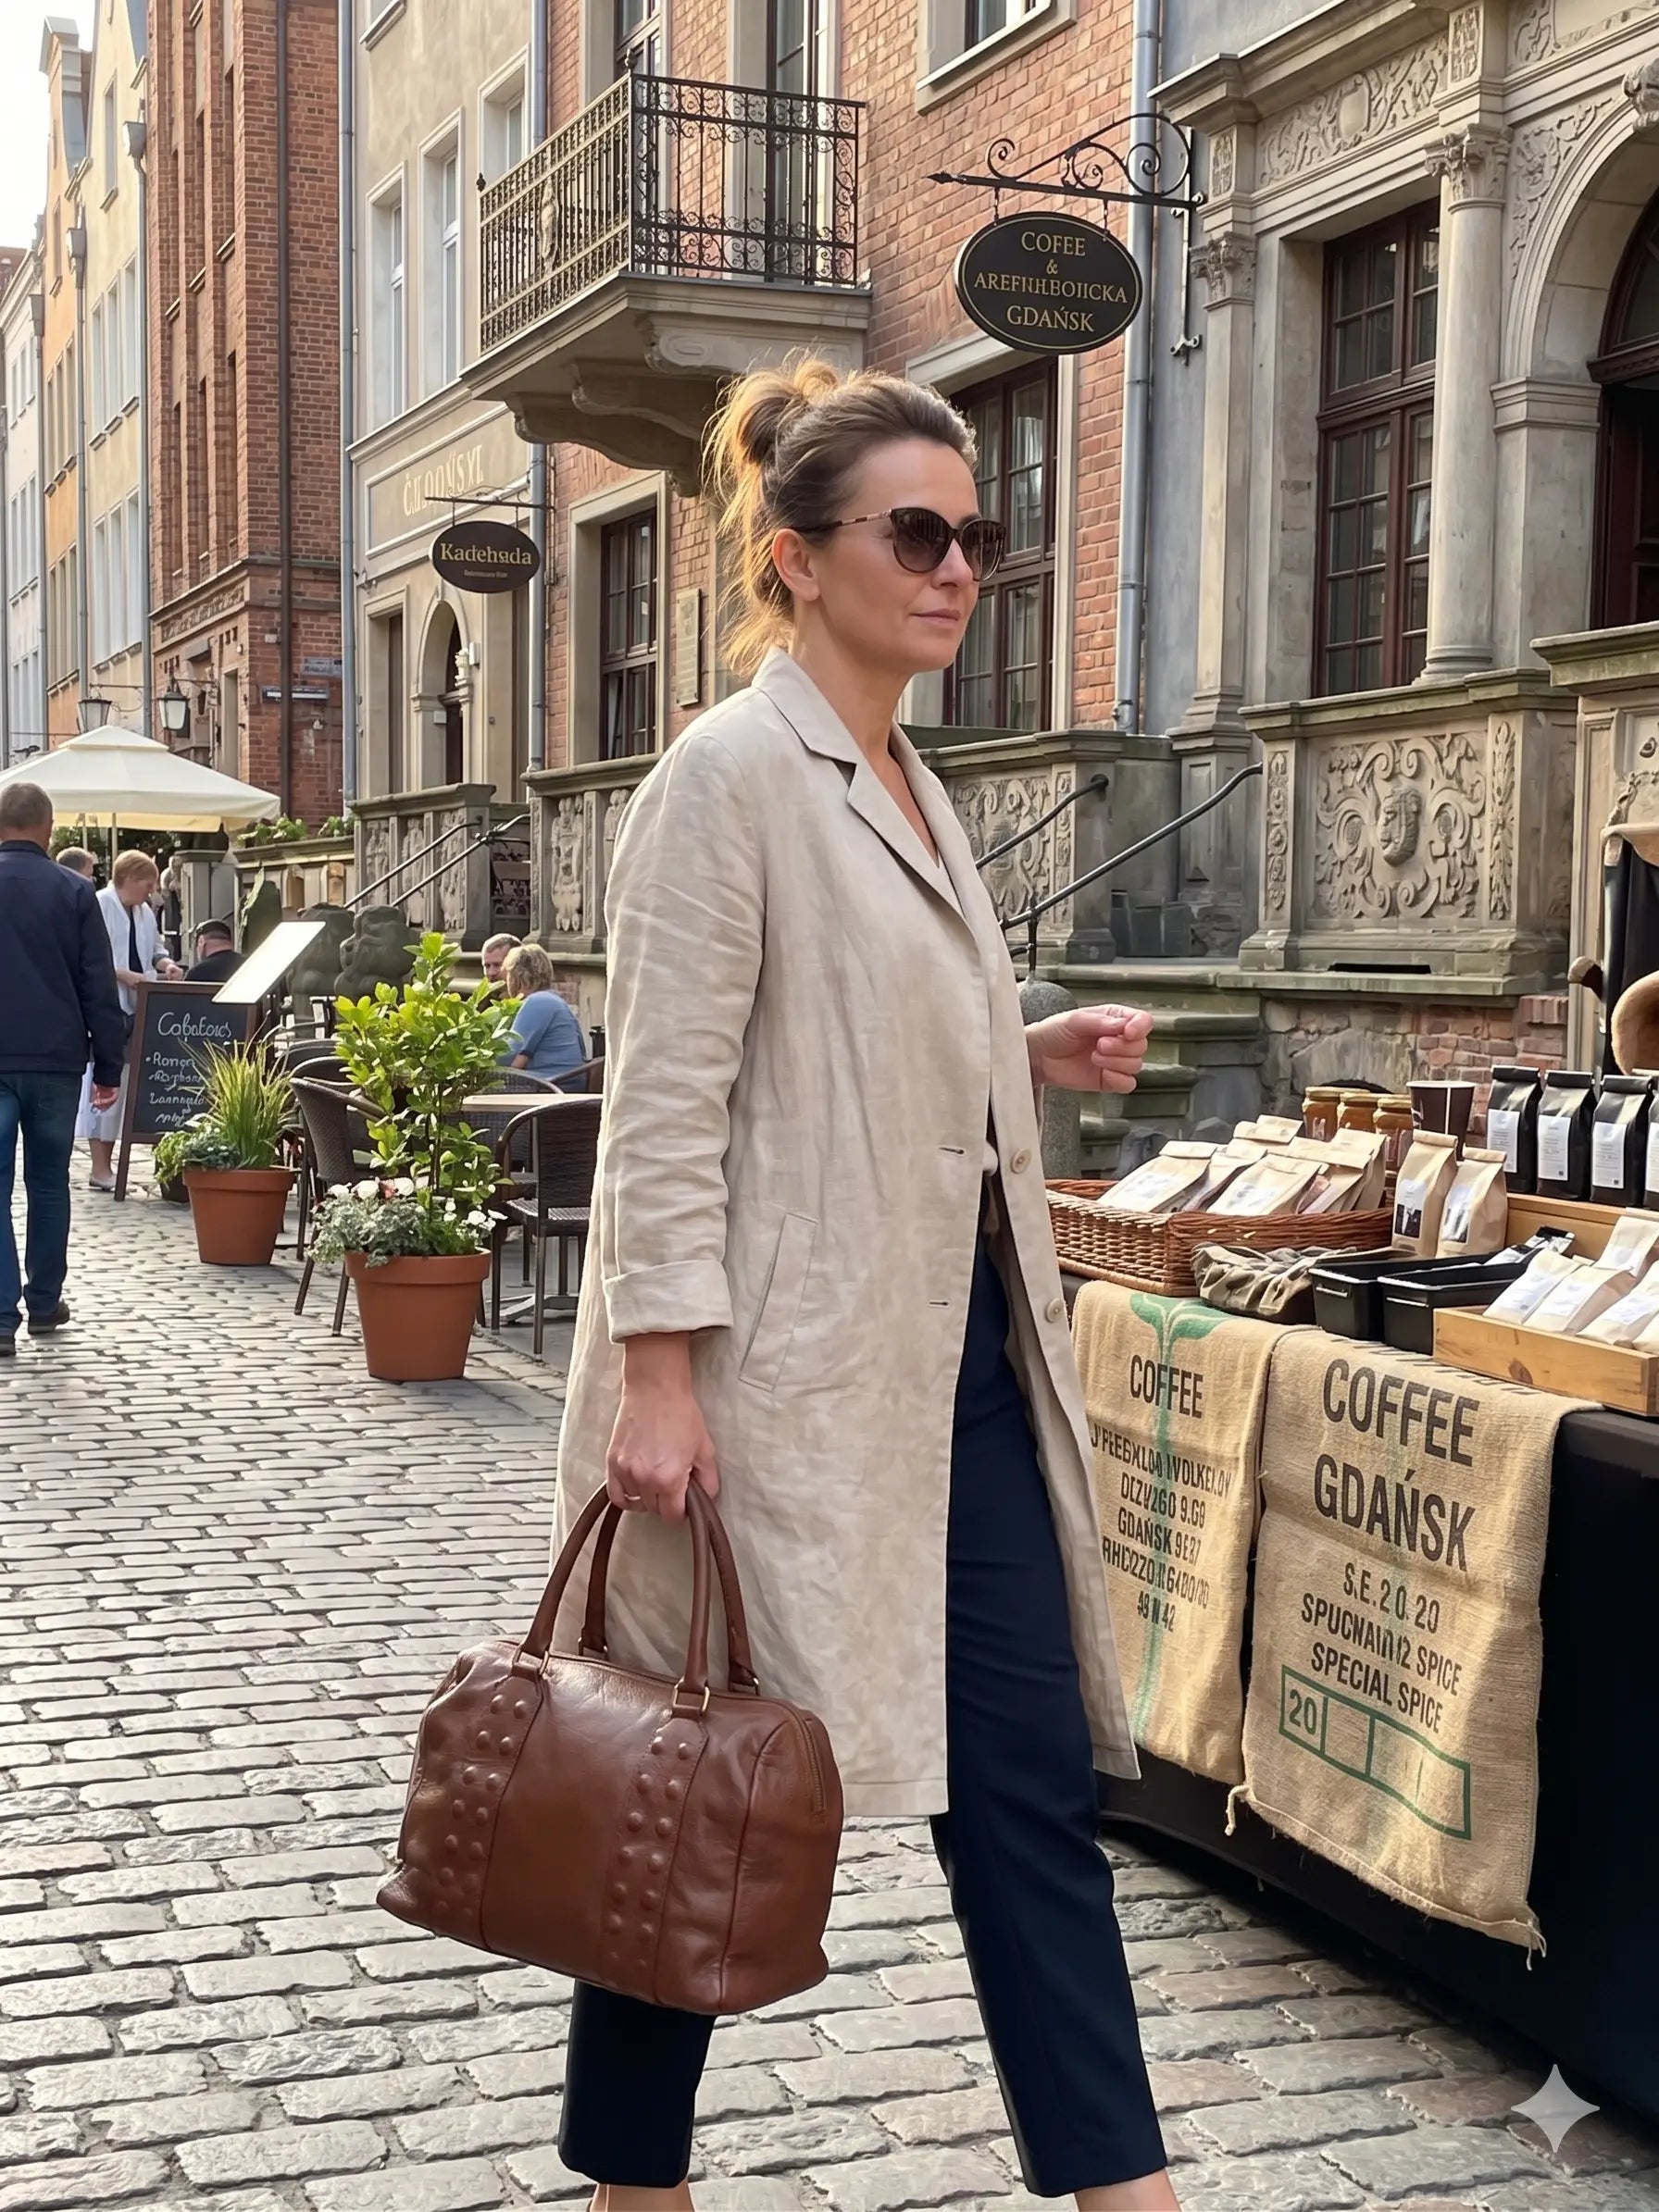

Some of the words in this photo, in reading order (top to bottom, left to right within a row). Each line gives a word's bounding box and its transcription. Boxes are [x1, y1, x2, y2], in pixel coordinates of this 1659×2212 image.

[1021, 231, 1086, 256] COFEE
[1046, 259, 1058, 275] &
[1007, 305, 1094, 332] GDAŃSK
[1130, 1355, 1204, 1419] COFFEE
[1323, 1358, 1480, 1467] COFFEE
[1117, 1506, 1172, 1556] GDAŃSK
[1315, 1453, 1476, 1572] GDAŃSK
[1311, 1642, 1392, 1707] SPECIAL
[1397, 1682, 1444, 1734] SPICE
[1416, 1646, 1463, 1696] SPICE
[1290, 1689, 1317, 1735] 20
